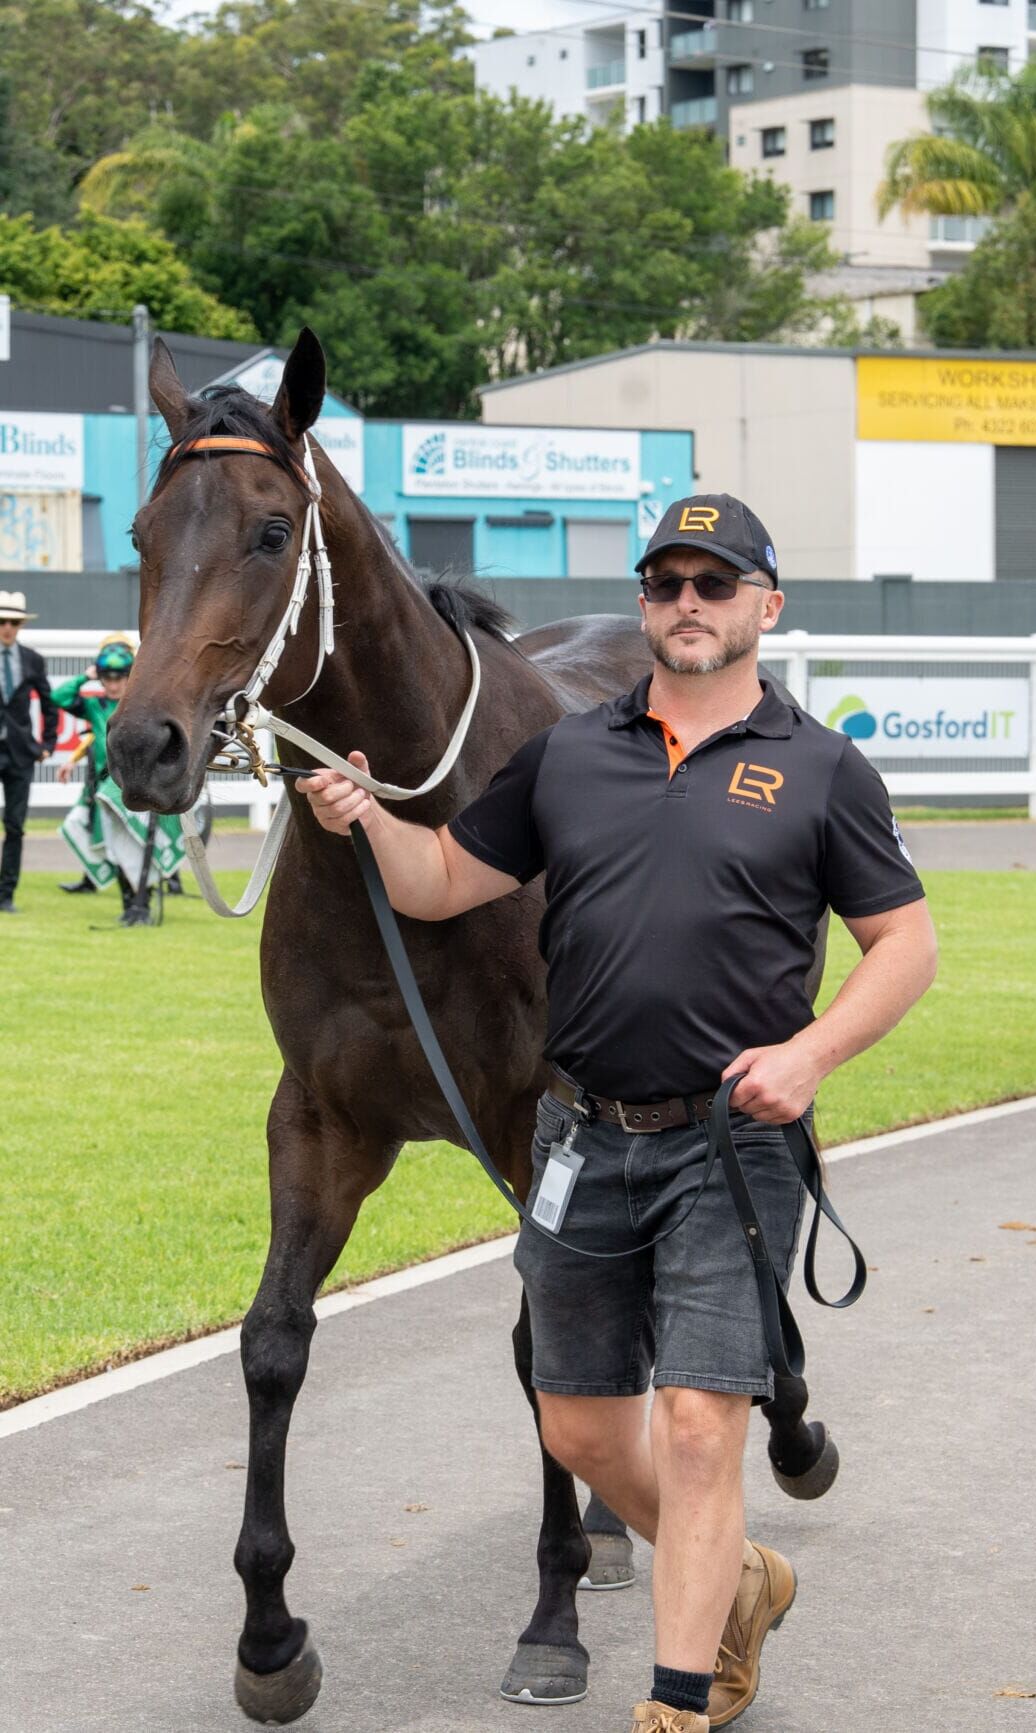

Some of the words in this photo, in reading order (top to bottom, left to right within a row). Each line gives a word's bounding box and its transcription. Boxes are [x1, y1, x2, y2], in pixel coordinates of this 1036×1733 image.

[0, 424, 77, 456] Blinds
[453, 447, 518, 470] Blinds
[545, 450, 631, 473] Shutters
[883, 709, 1016, 739] GosfordIT
